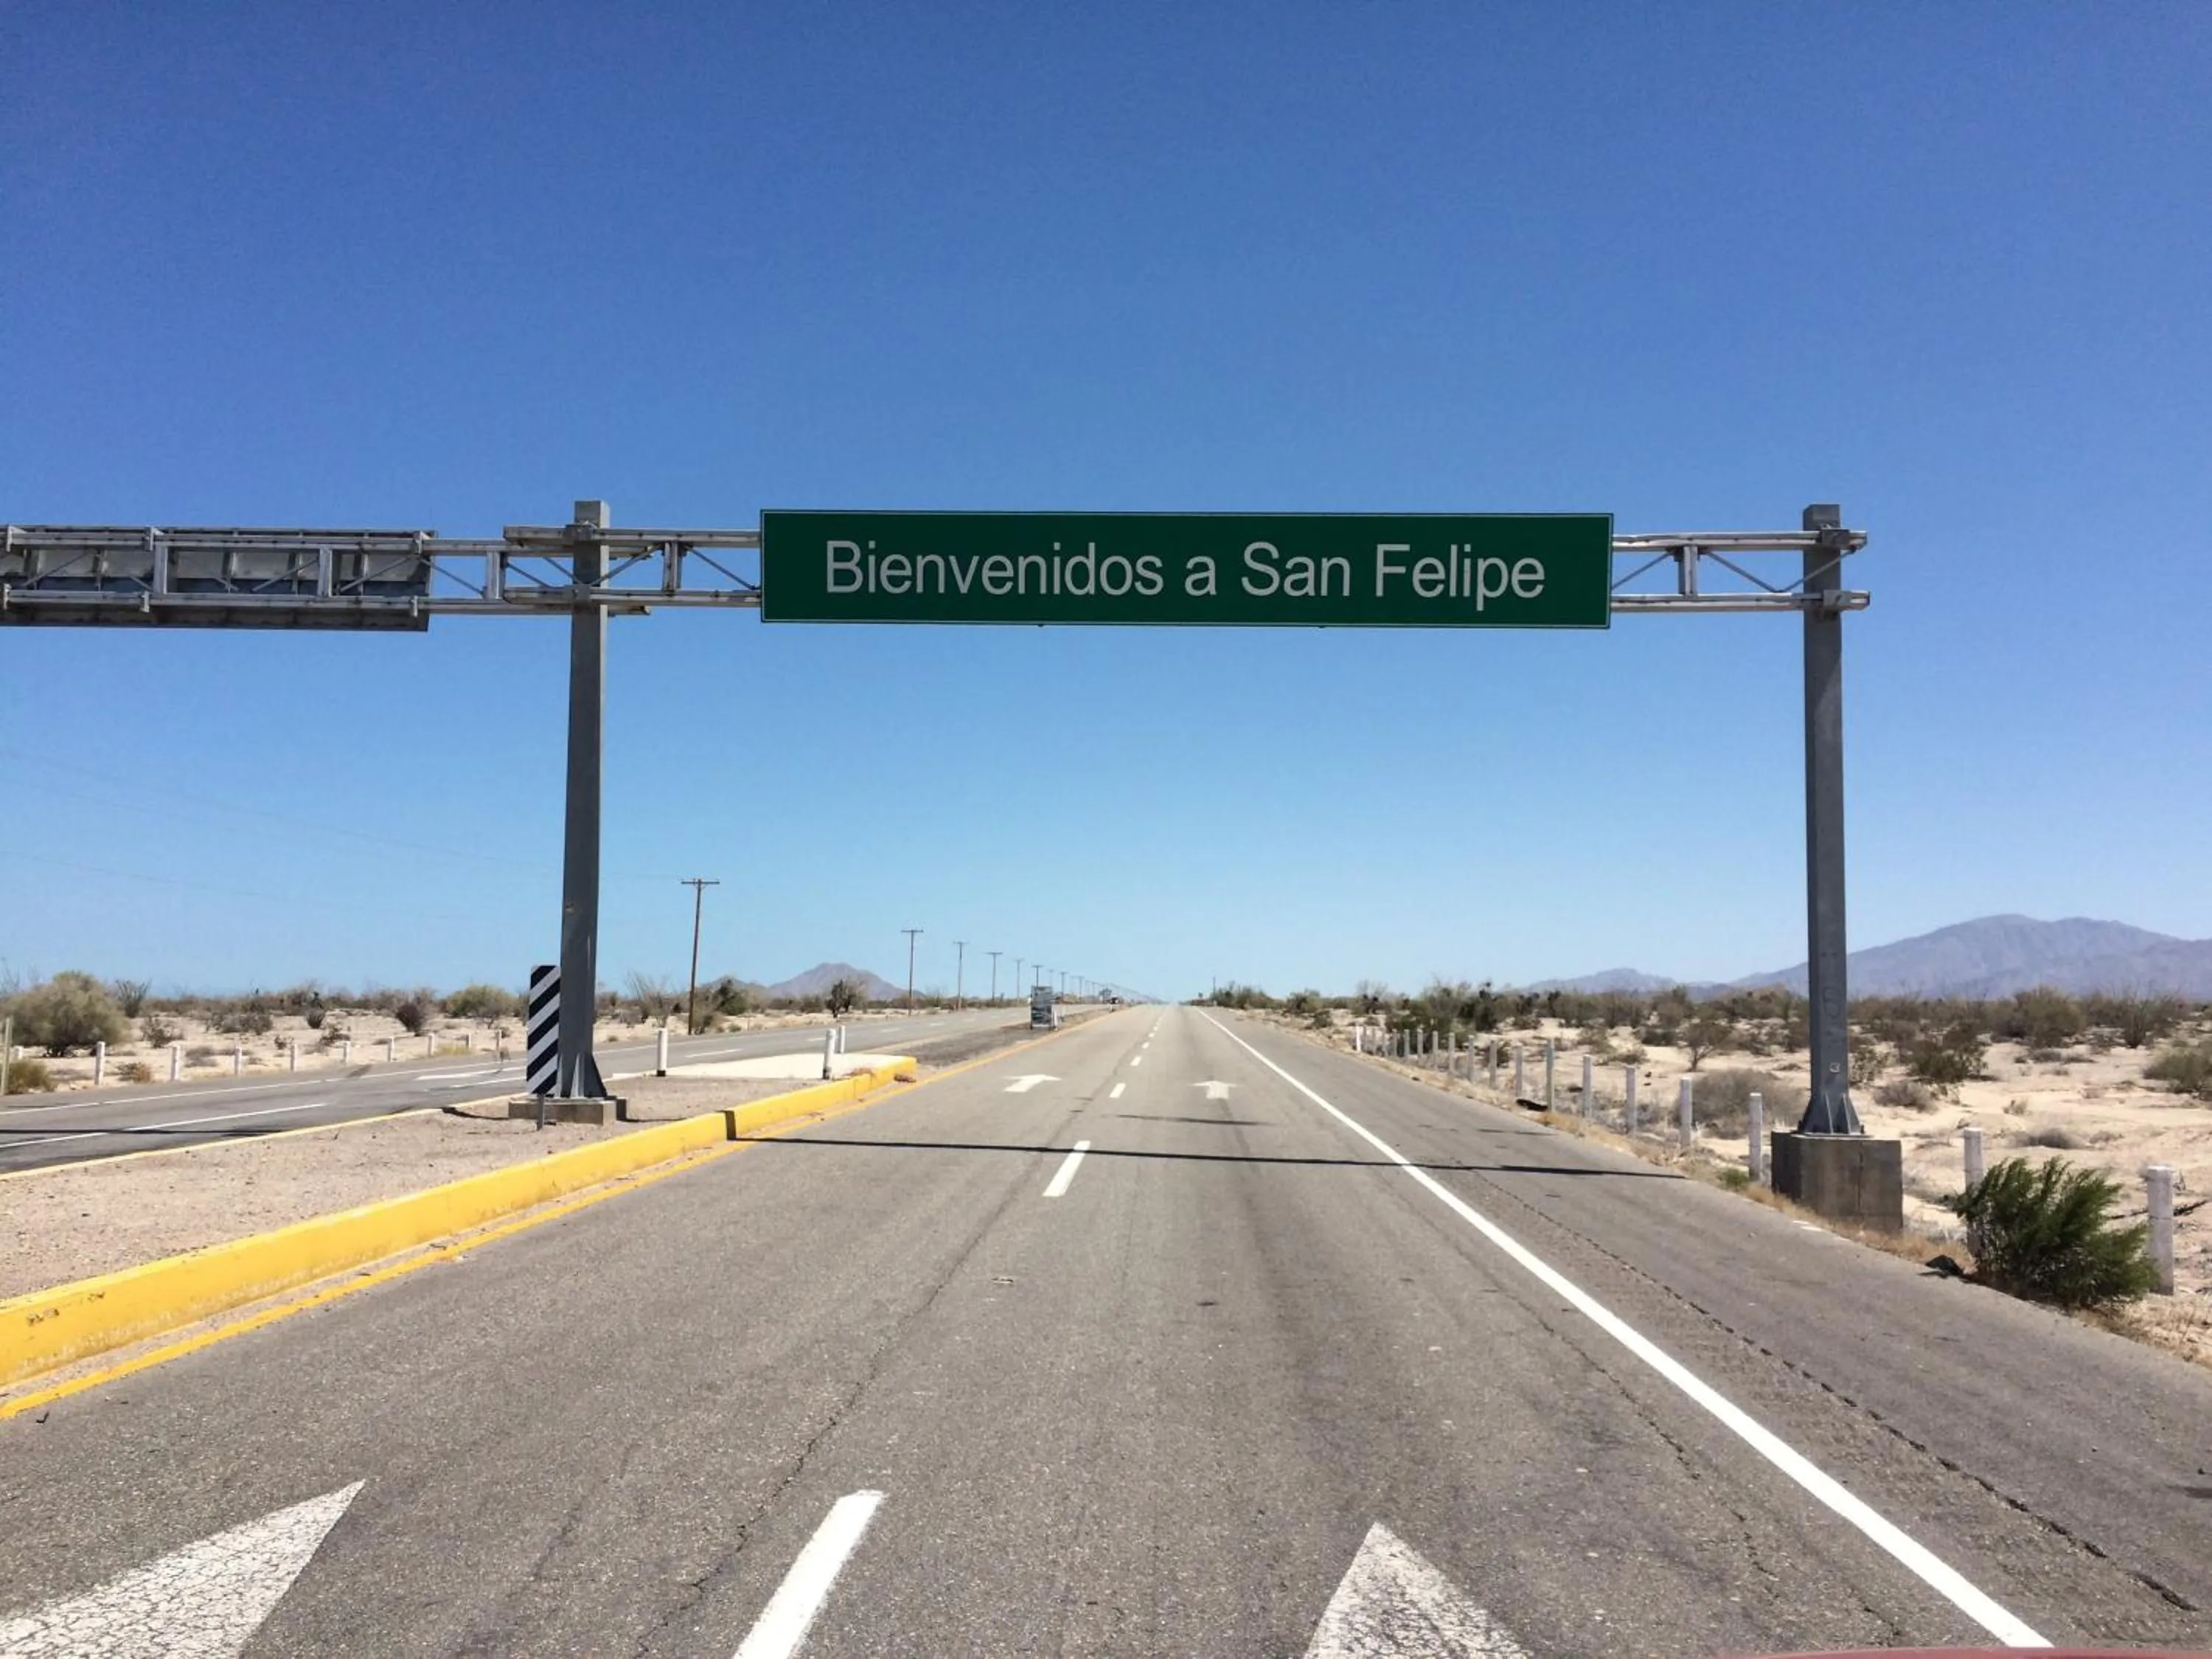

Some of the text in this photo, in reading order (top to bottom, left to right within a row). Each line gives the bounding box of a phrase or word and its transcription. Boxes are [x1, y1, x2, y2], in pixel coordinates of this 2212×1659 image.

[825, 539, 1545, 611] Bienvenidos a San Felipe
